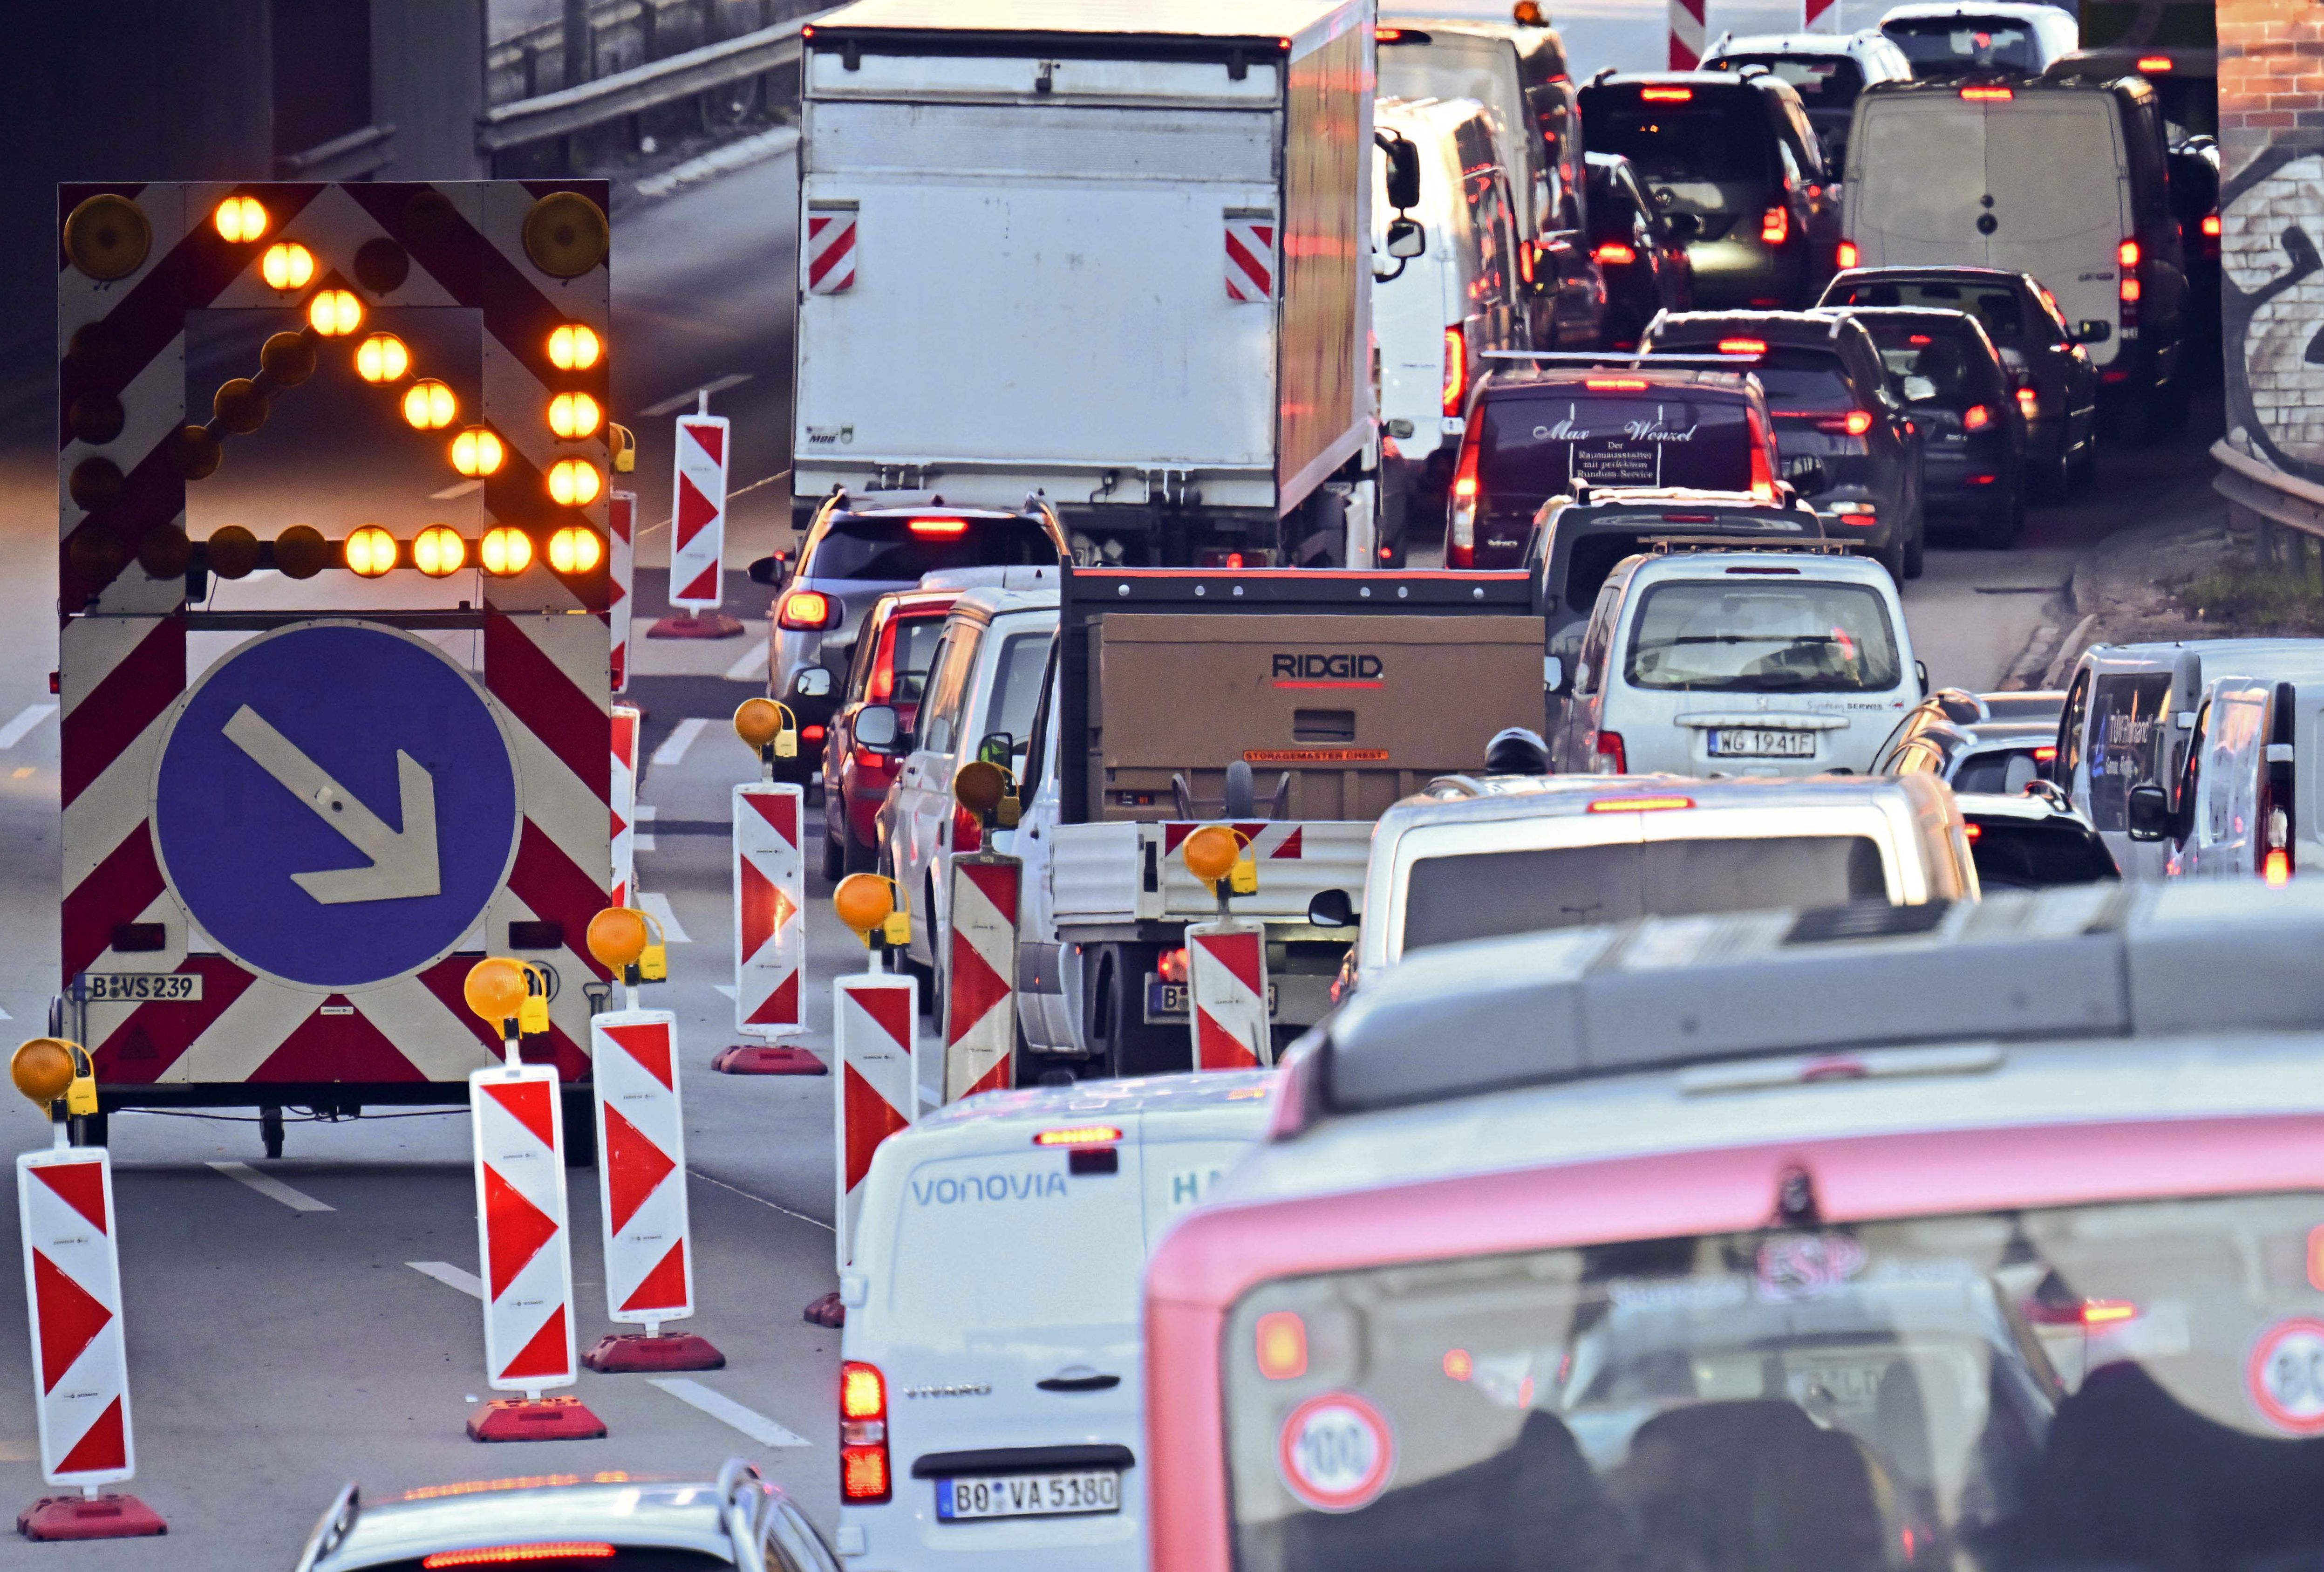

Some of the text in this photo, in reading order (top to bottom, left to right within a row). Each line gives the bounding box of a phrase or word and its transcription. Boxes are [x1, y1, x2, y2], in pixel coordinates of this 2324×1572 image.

[1533, 419, 1698, 441] Max Wenzel
[1608, 441, 1624, 450] Der
[1272, 654, 1383, 678] RIDGID
[1722, 731, 1810, 753] WG 1941F
[1246, 751, 1343, 760] STORAGEMASTER
[93, 977, 193, 998] B VS 239
[1010, 1479, 1043, 1509] VA
[1049, 1476, 1114, 1507] 5180
